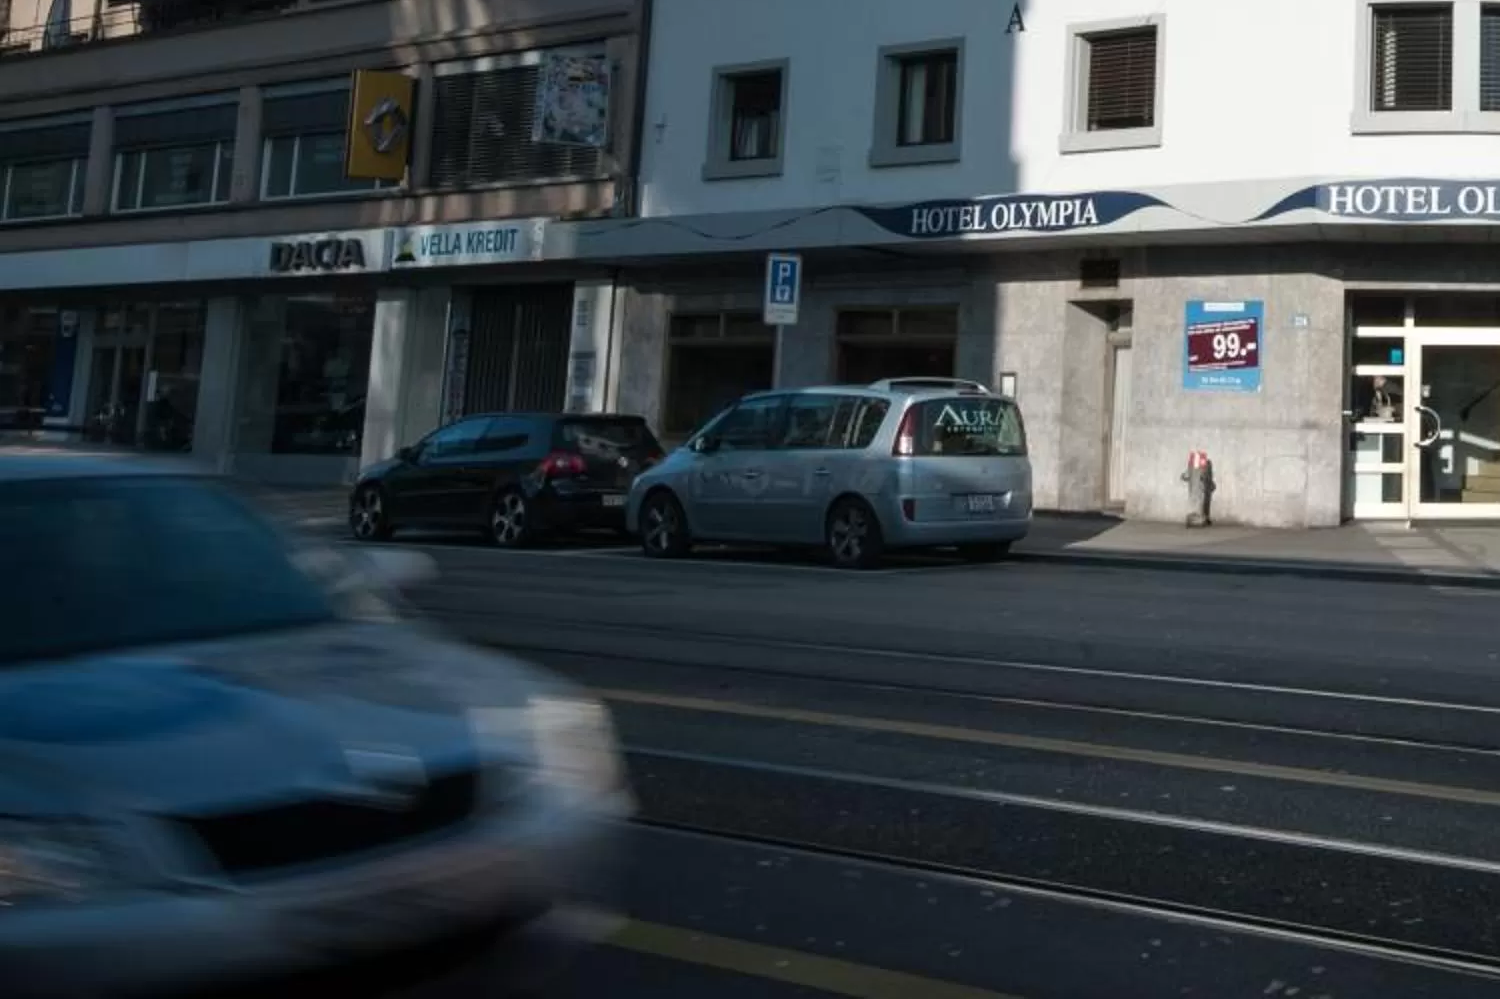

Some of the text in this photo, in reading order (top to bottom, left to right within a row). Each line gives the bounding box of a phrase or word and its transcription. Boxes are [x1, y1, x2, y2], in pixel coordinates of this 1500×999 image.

[1328, 185, 1450, 215] HOTEL
[911, 198, 1099, 233] HOTEL OLYMPIA
[270, 238, 367, 271] DACIA
[420, 228, 519, 256] VELLA KREDIT
[1212, 332, 1257, 359] 99.-
